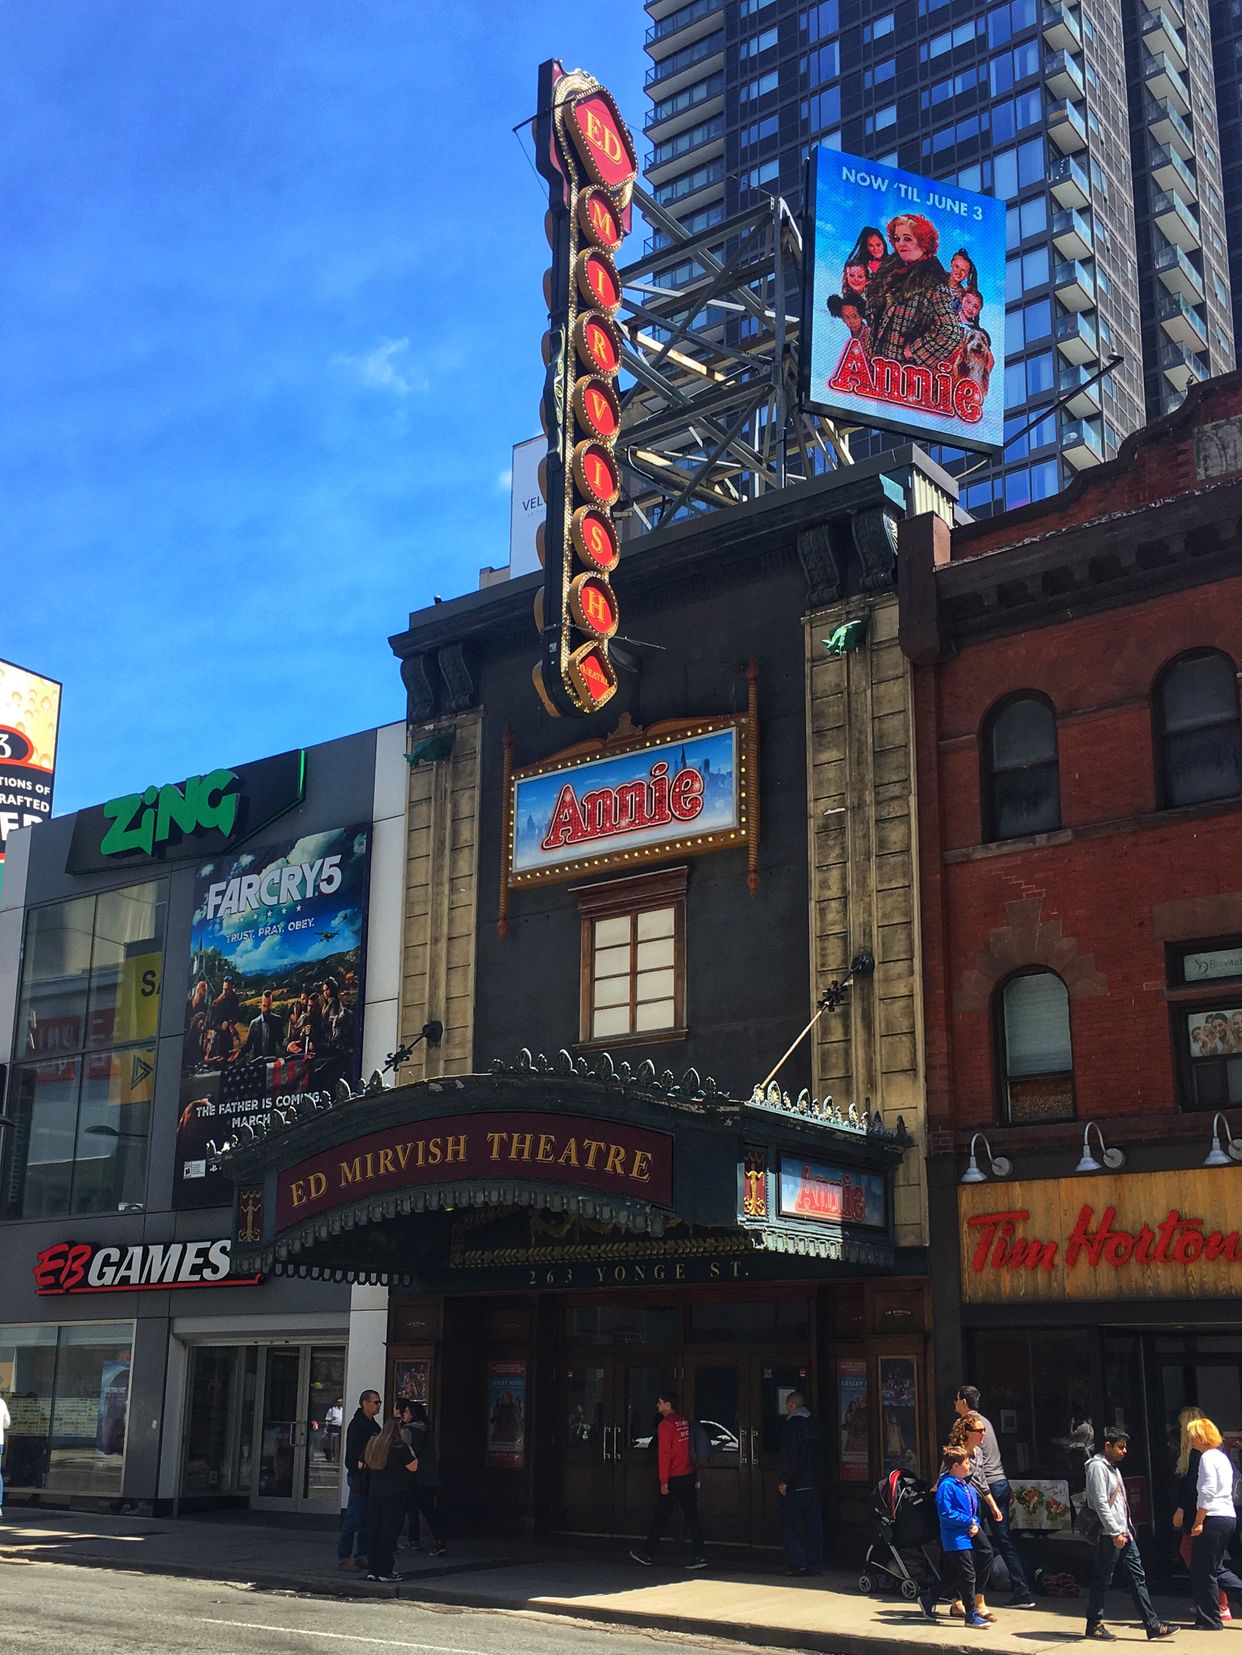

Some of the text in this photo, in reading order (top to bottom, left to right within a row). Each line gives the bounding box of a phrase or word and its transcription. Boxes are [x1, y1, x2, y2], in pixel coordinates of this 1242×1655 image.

[585, 109, 622, 167] ED
[841, 166, 889, 191] NOW
[926, 191, 968, 218] JUNE
[973, 205, 983, 221] 3
[830, 337, 984, 424] Annie
[587, 202, 613, 624] MIRVISH
[579, 663, 610, 687] THEATR
[35, 784, 51, 796] OF
[541, 761, 705, 849] Annie
[226, 918, 315, 944] TRUST. PRAY. OBEY.
[196, 1105, 216, 1118] THE
[218, 1099, 259, 1115] FATHER
[261, 1097, 272, 1109] IS
[289, 1132, 654, 1208] ED MIRVISH THEATRE
[795, 1165, 866, 1222] Annie
[967, 1209, 1058, 1273] Tim
[529, 1261, 749, 1285] 263 YONGE ST.
